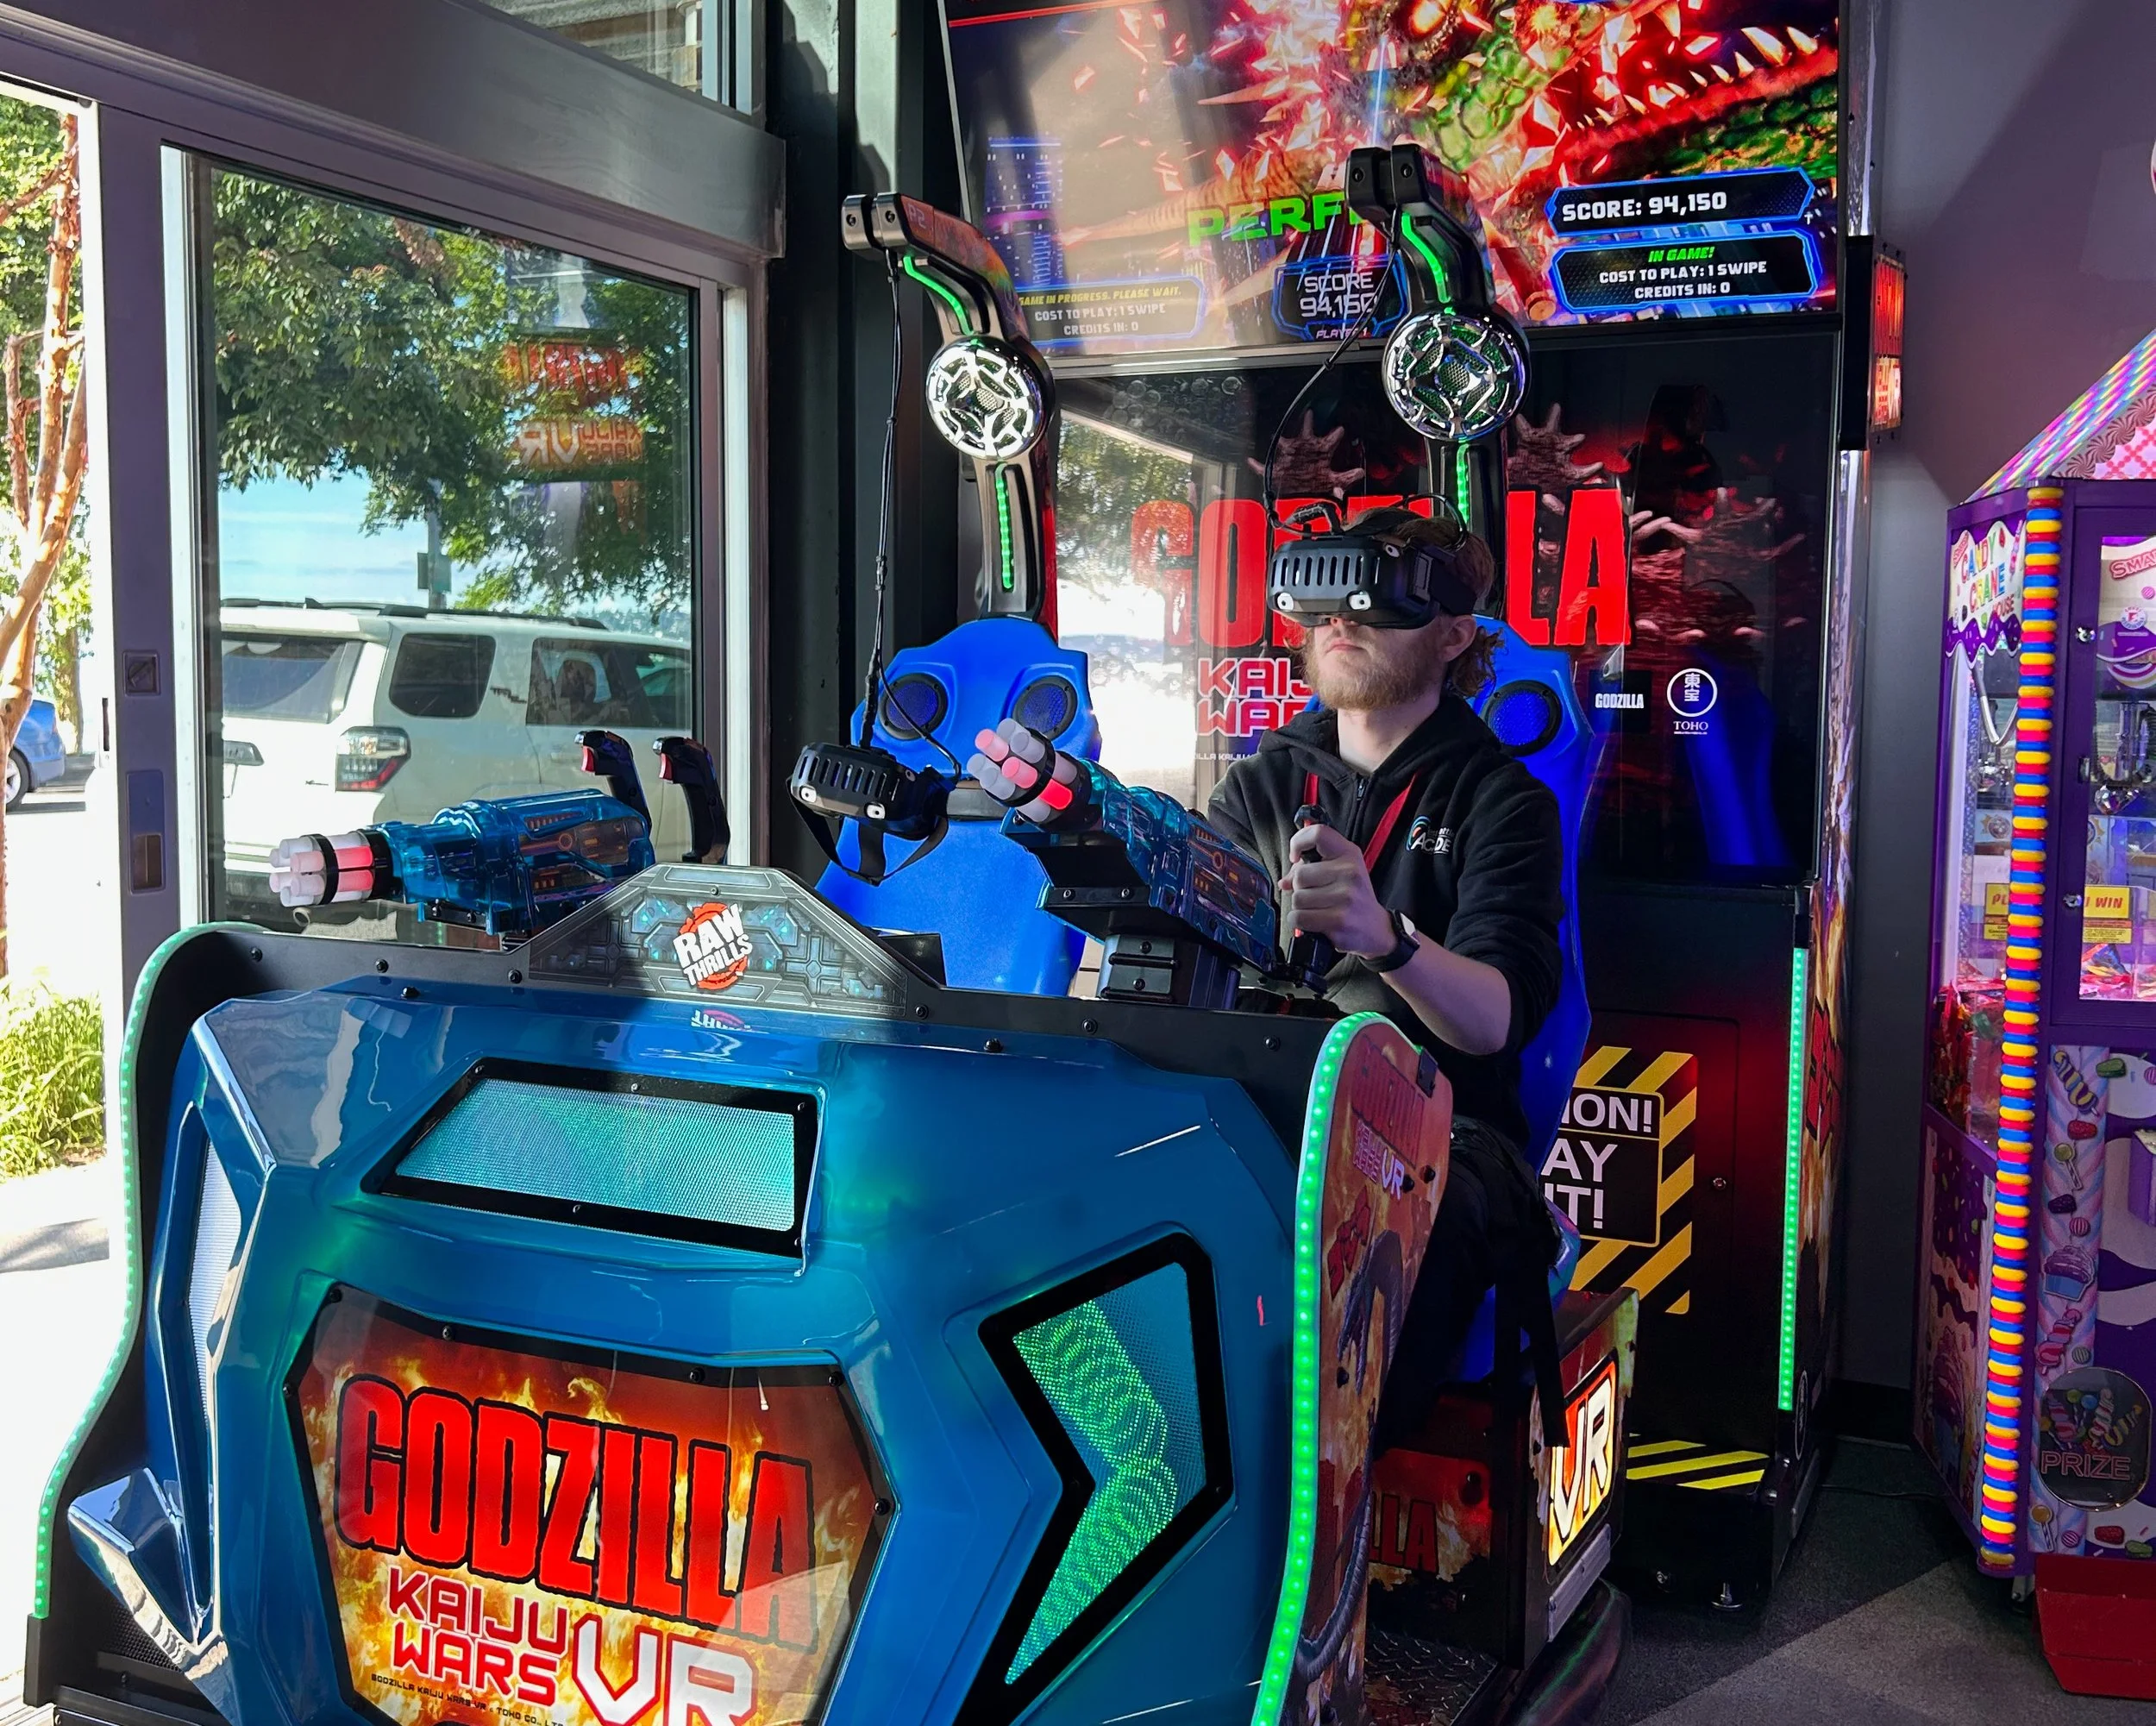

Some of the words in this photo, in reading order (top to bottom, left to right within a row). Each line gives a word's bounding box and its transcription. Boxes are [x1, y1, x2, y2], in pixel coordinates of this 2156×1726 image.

[1562, 198, 1642, 222] SCORE:
[1648, 191, 1727, 216] 94,150
[1648, 249, 1664, 263] IN
[1666, 246, 1715, 262] GAME!
[1304, 272, 1374, 294] SCORE
[1599, 269, 1636, 284] COST
[1639, 267, 1658, 281] TO
[1660, 265, 1705, 280] PLAY:
[1708, 263, 1714, 277] 1
[1717, 260, 1767, 277] SWIPE
[1046, 294, 1056, 304] IN
[1057, 291, 1112, 304] PROGRESS.
[1112, 289, 1150, 299] PLEASE
[1152, 286, 1181, 298] WAIT.
[1634, 283, 1694, 299] CREDITS
[1697, 282, 1717, 296] IN:
[1035, 309, 1063, 322] COST
[1066, 308, 1081, 320] TO
[1083, 306, 1118, 318] PLAY:
[1120, 305, 1125, 317] 1
[1128, 303, 1166, 316] SWIPE
[1063, 323, 1111, 336] CREDITS
[1113, 321, 1129, 332] IN:
[1961, 530, 1997, 584] CANDY
[1970, 562, 2005, 613] CRANE
[1595, 693, 1645, 709] GODZILLA
[1673, 721, 1709, 731] TOHO
[2095, 895, 2123, 909] WIN
[673, 903, 745, 969] RAW
[682, 932, 754, 987] THRILLS
[2040, 1451, 2131, 1481] PRIZE
[337, 1376, 817, 1650] GODZILLA
[387, 1565, 574, 1659] KAIJU
[391, 1622, 561, 1710] WARS
[570, 1613, 759, 1726] VR
[371, 1673, 416, 1692] GODZILLA
[417, 1686, 444, 1701] KAIJU
[447, 1693, 473, 1707] WARS
[473, 1701, 487, 1711] VR
[497, 1707, 522, 1720] TOHO
